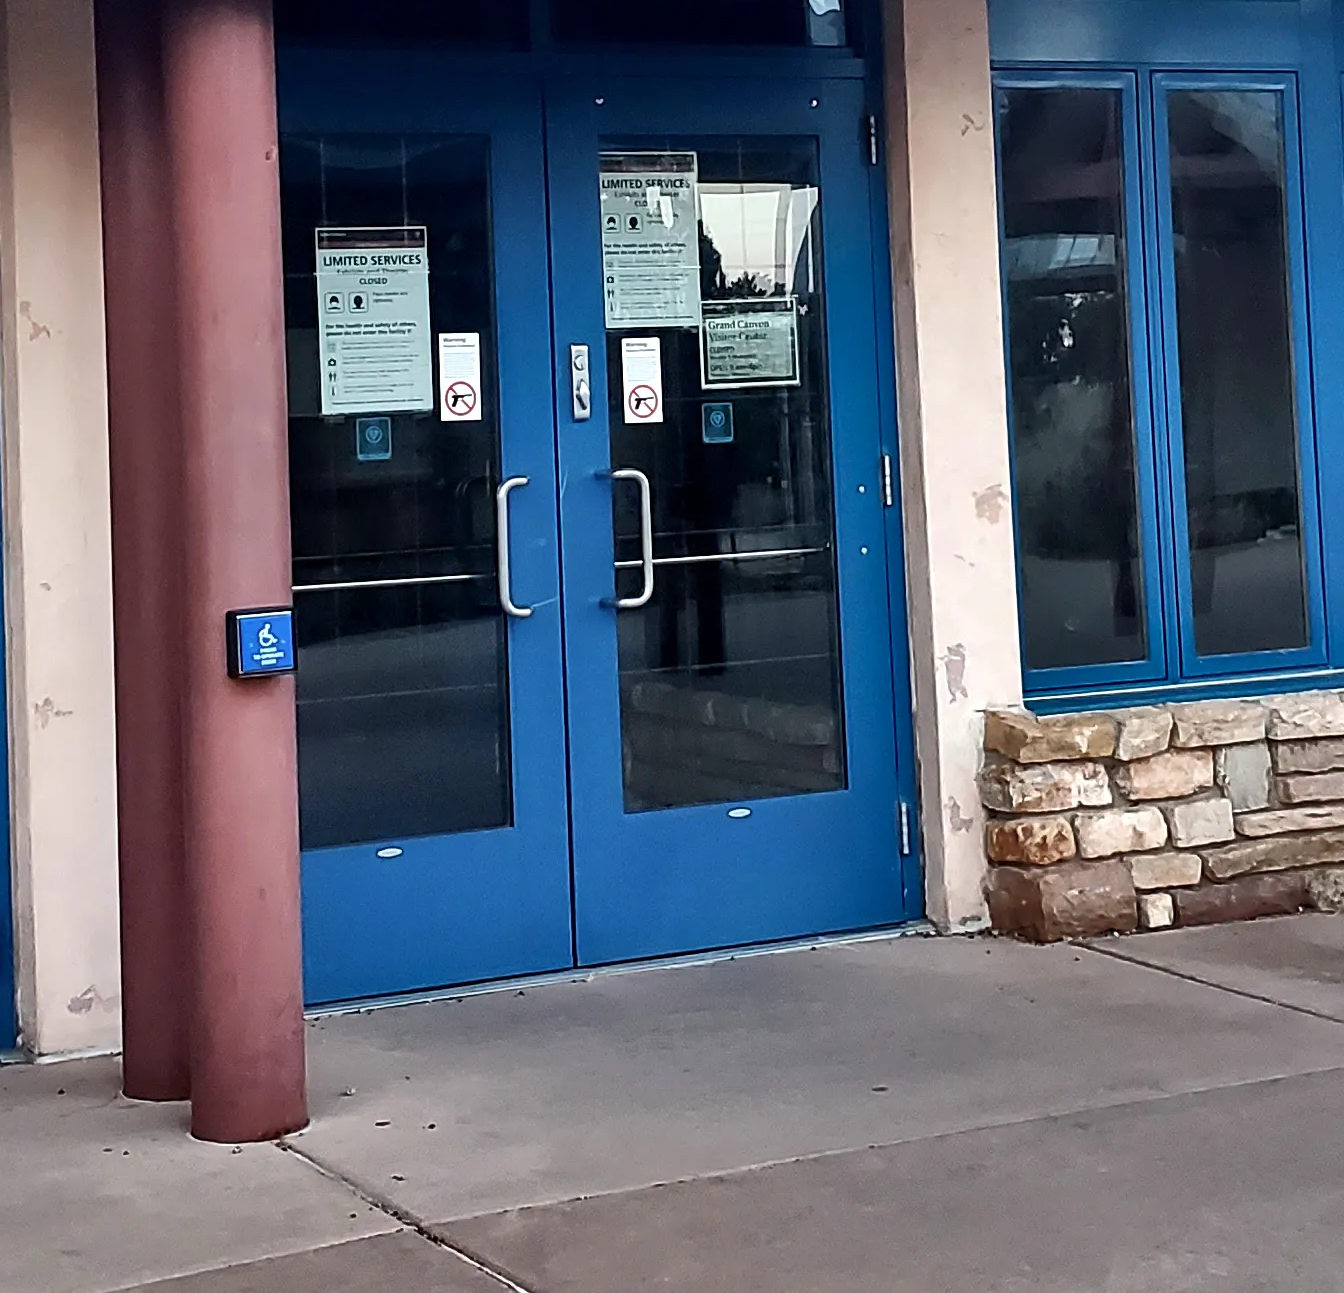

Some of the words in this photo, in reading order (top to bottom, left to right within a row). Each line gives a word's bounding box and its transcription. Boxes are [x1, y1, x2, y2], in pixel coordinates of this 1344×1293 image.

[601, 178, 643, 189] LIMITED
[645, 178, 691, 189] SERVICES
[323, 255, 368, 267] LIMITED
[370, 253, 422, 266] SERVICES
[359, 277, 388, 285] CLOSED
[707, 320, 736, 329] Grand
